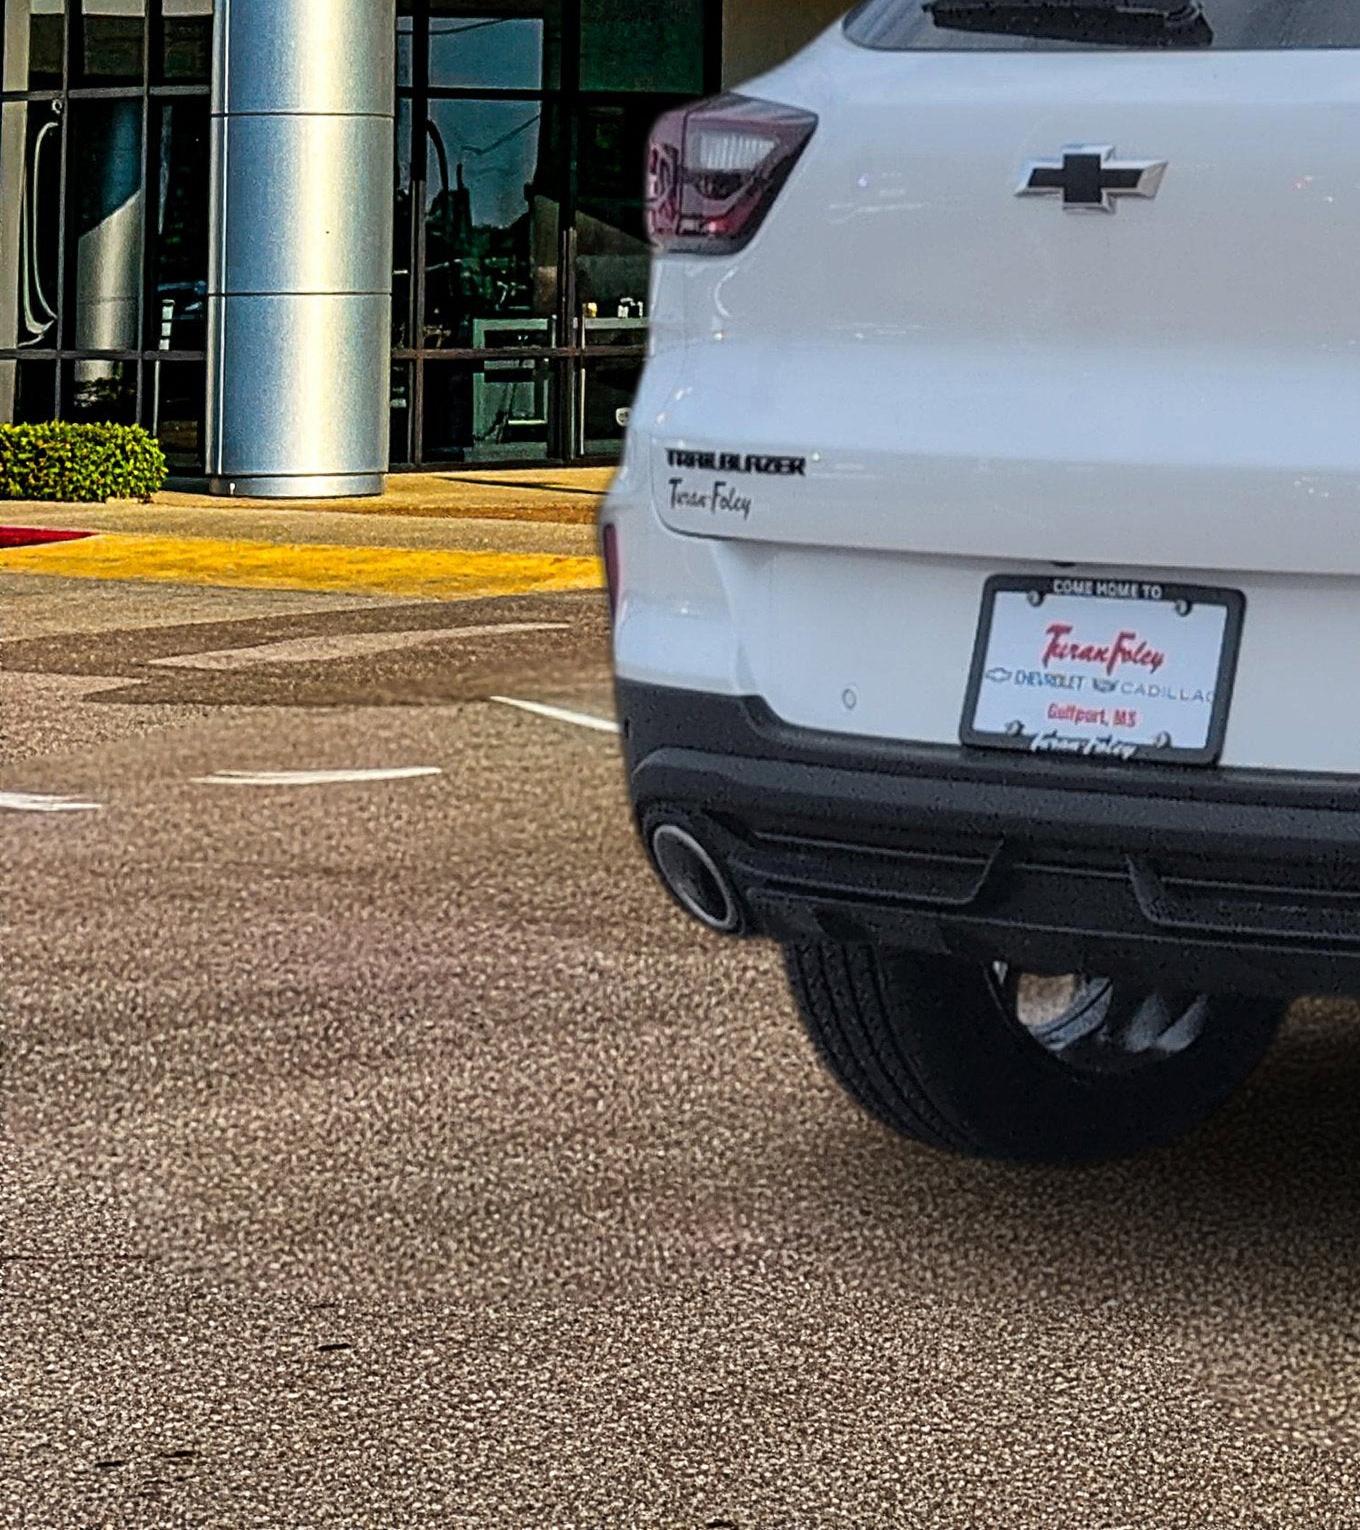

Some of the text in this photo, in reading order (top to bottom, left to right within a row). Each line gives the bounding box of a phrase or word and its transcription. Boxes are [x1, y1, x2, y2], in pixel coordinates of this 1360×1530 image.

[665, 448, 806, 476] TRAILBLAZER
[1052, 579, 1163, 600] COME HOME TO
[1013, 669, 1085, 692] CHEVROLET
[1113, 709, 1137, 728] MS
